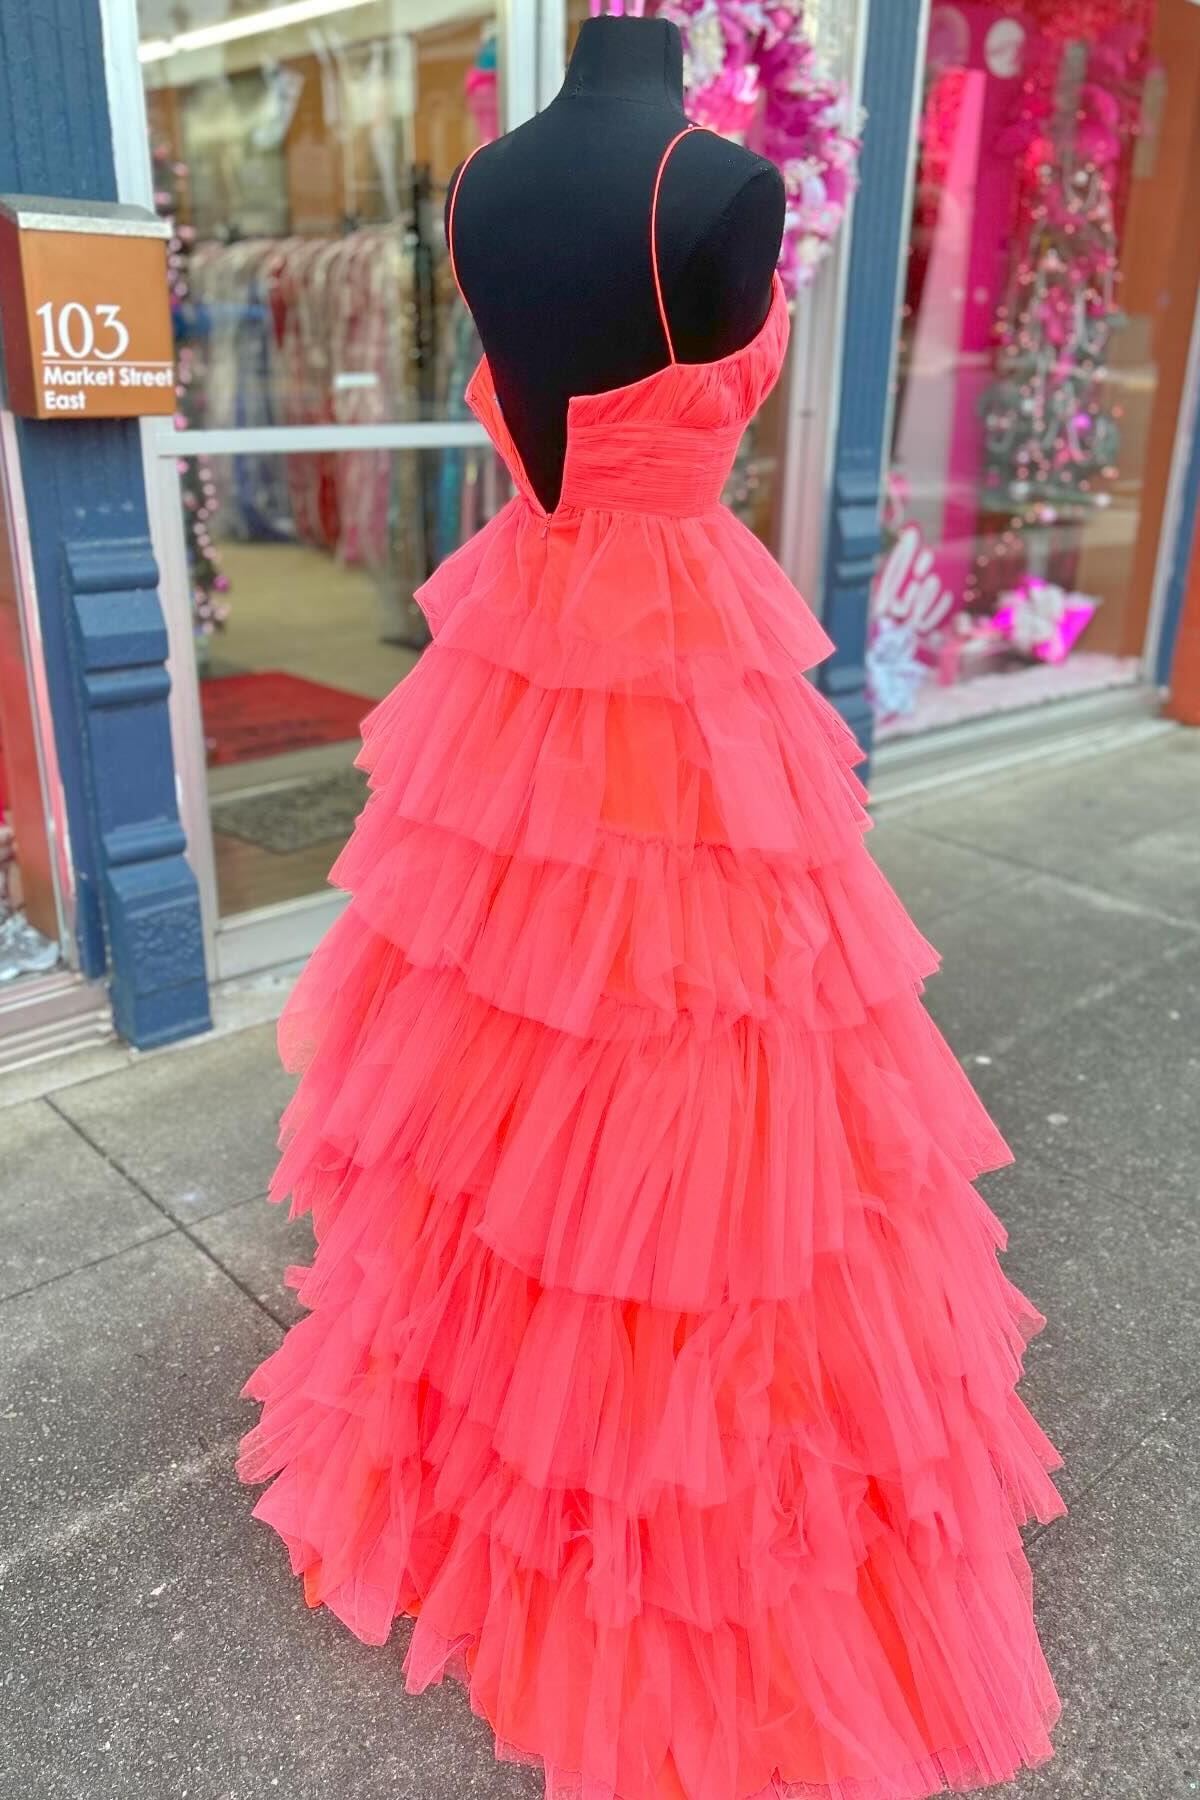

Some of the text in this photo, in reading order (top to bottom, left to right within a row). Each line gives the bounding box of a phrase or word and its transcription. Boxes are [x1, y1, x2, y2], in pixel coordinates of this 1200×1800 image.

[36, 302, 129, 359] 103
[44, 366, 174, 386] Market Street
[44, 390, 86, 410] East
